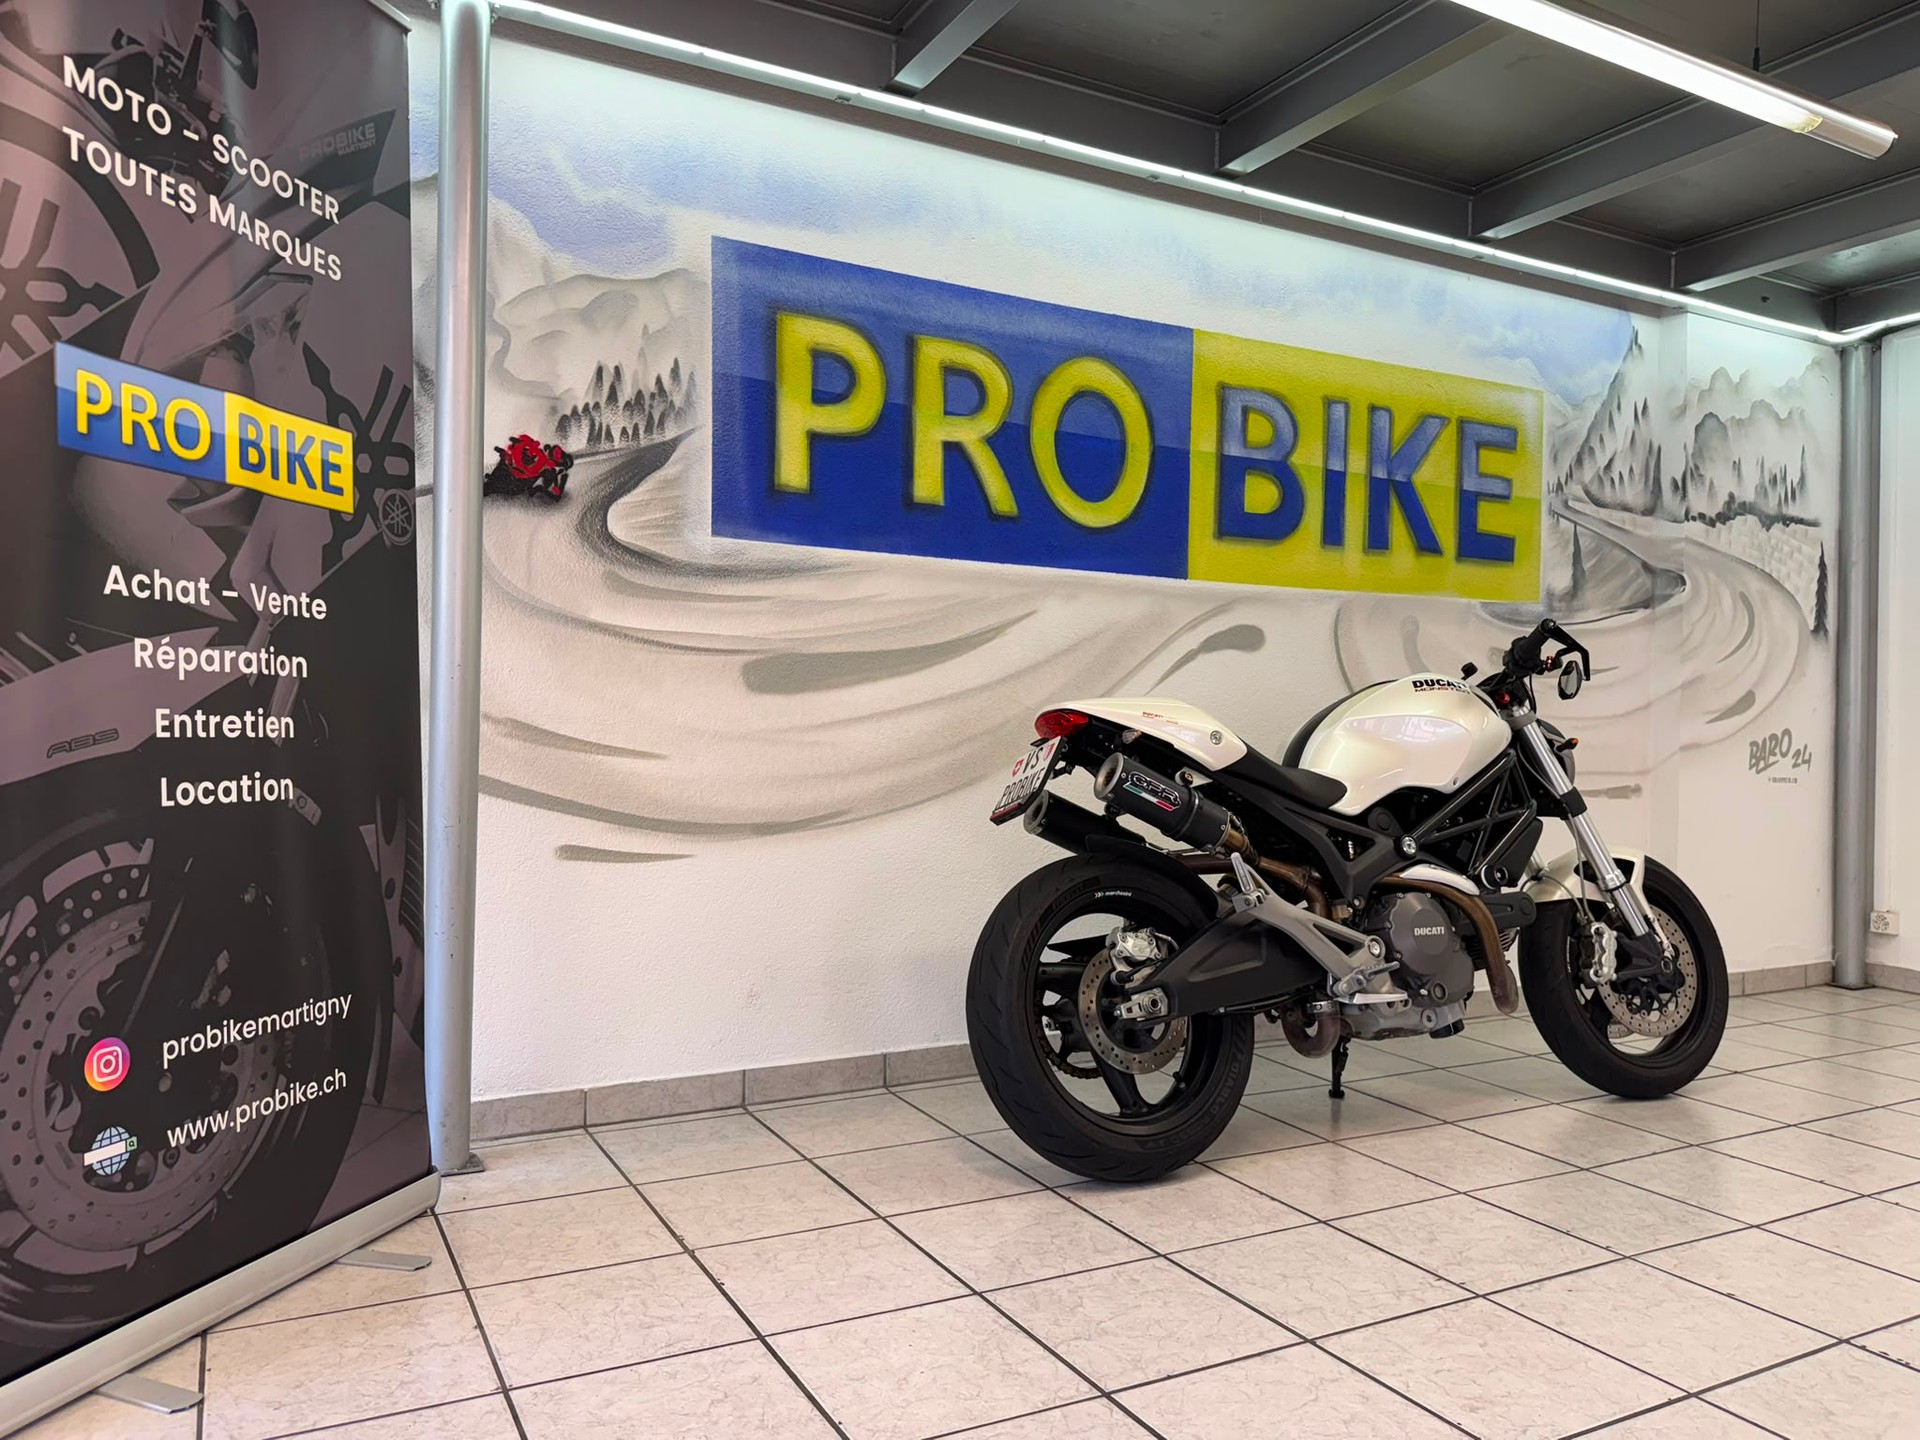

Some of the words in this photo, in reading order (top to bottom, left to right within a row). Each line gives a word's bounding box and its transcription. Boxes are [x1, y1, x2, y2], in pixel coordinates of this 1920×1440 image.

[63, 55, 172, 136] MOTO
[213, 133, 340, 225] SCOOTER
[62, 126, 196, 214] TOUTES
[209, 194, 342, 281] MARQUES
[76, 369, 212, 461] PRO
[238, 413, 344, 496] BIKE
[772, 309, 1153, 529] PRO
[1215, 383, 1517, 563] BIKE
[103, 564, 210, 606] Achat
[250, 583, 327, 620] Vente
[134, 637, 308, 680] Réparation
[46, 728, 120, 758] ABS
[155, 707, 295, 739] Entretien
[1022, 746, 1044, 774] VS
[1791, 743, 1812, 773] 24
[160, 771, 294, 807] Location
[995, 767, 1046, 811] PROBIKE
[1414, 927, 1445, 936] DUCATI
[162, 994, 352, 1068] probikemartigny
[167, 1068, 347, 1147] www.probike.ch
